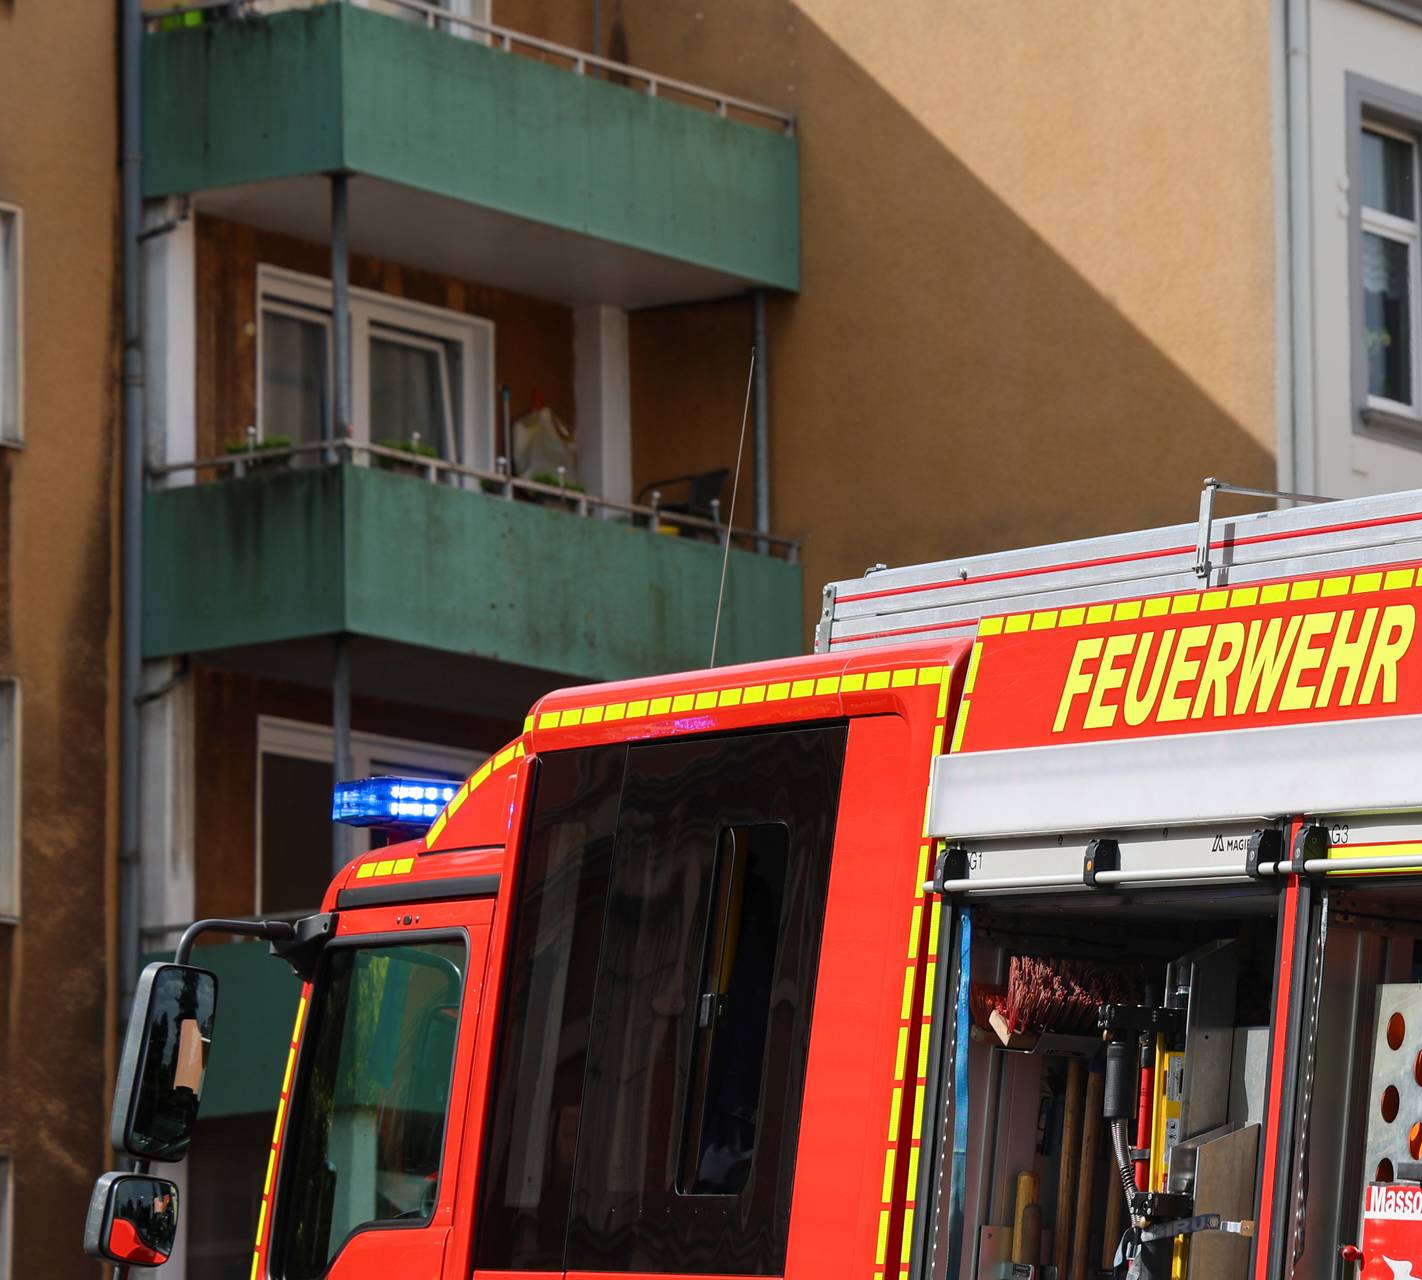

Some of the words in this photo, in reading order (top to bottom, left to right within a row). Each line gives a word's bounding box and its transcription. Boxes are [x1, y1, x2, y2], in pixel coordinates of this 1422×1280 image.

[1051, 604, 1416, 733] FEUERWEHR
[1331, 824, 1349, 844] G3
[969, 851, 983, 870] G1
